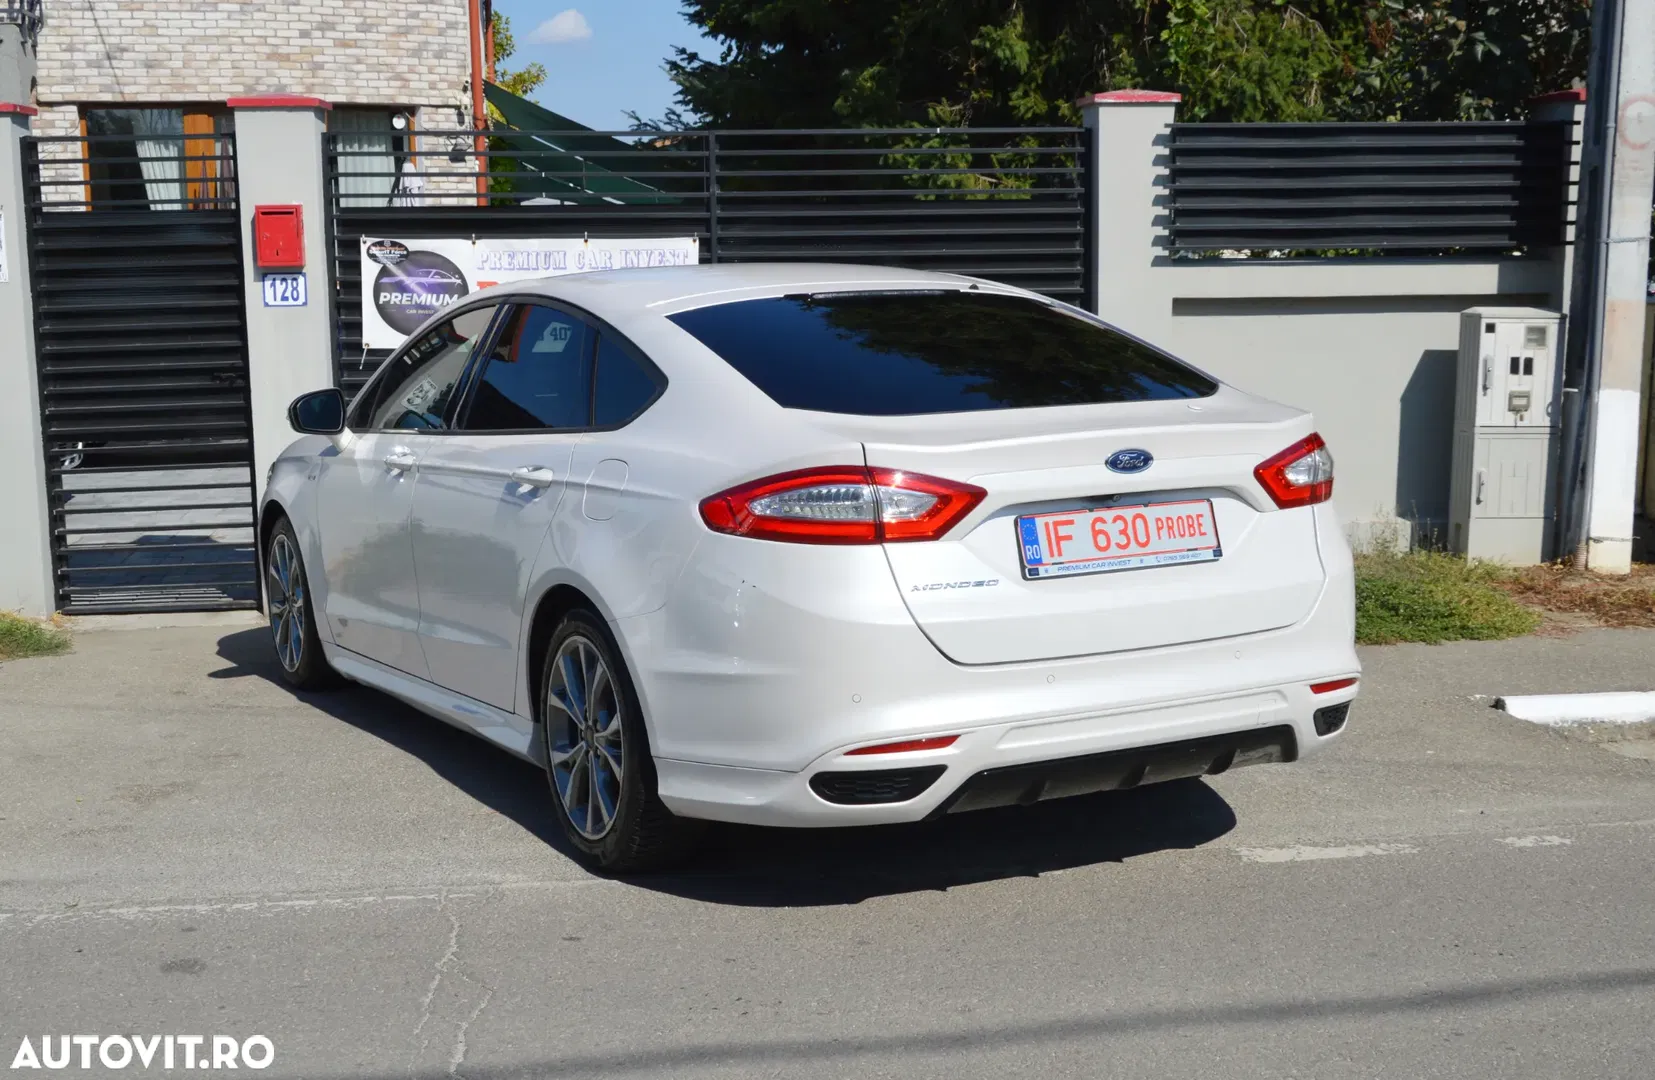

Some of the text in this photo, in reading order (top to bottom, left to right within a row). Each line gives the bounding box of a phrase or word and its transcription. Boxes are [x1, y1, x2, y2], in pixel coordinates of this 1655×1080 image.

[477, 249, 689, 271] PREMIUM CAR INVEST
[270, 277, 300, 302] 128
[379, 292, 458, 306] PREMIUM
[1117, 453, 1144, 468] Ford
[1044, 512, 1207, 558] IF 630 PROBE
[1025, 545, 1041, 561] RO
[1057, 559, 1132, 573] PREMIUM CAR INVEST
